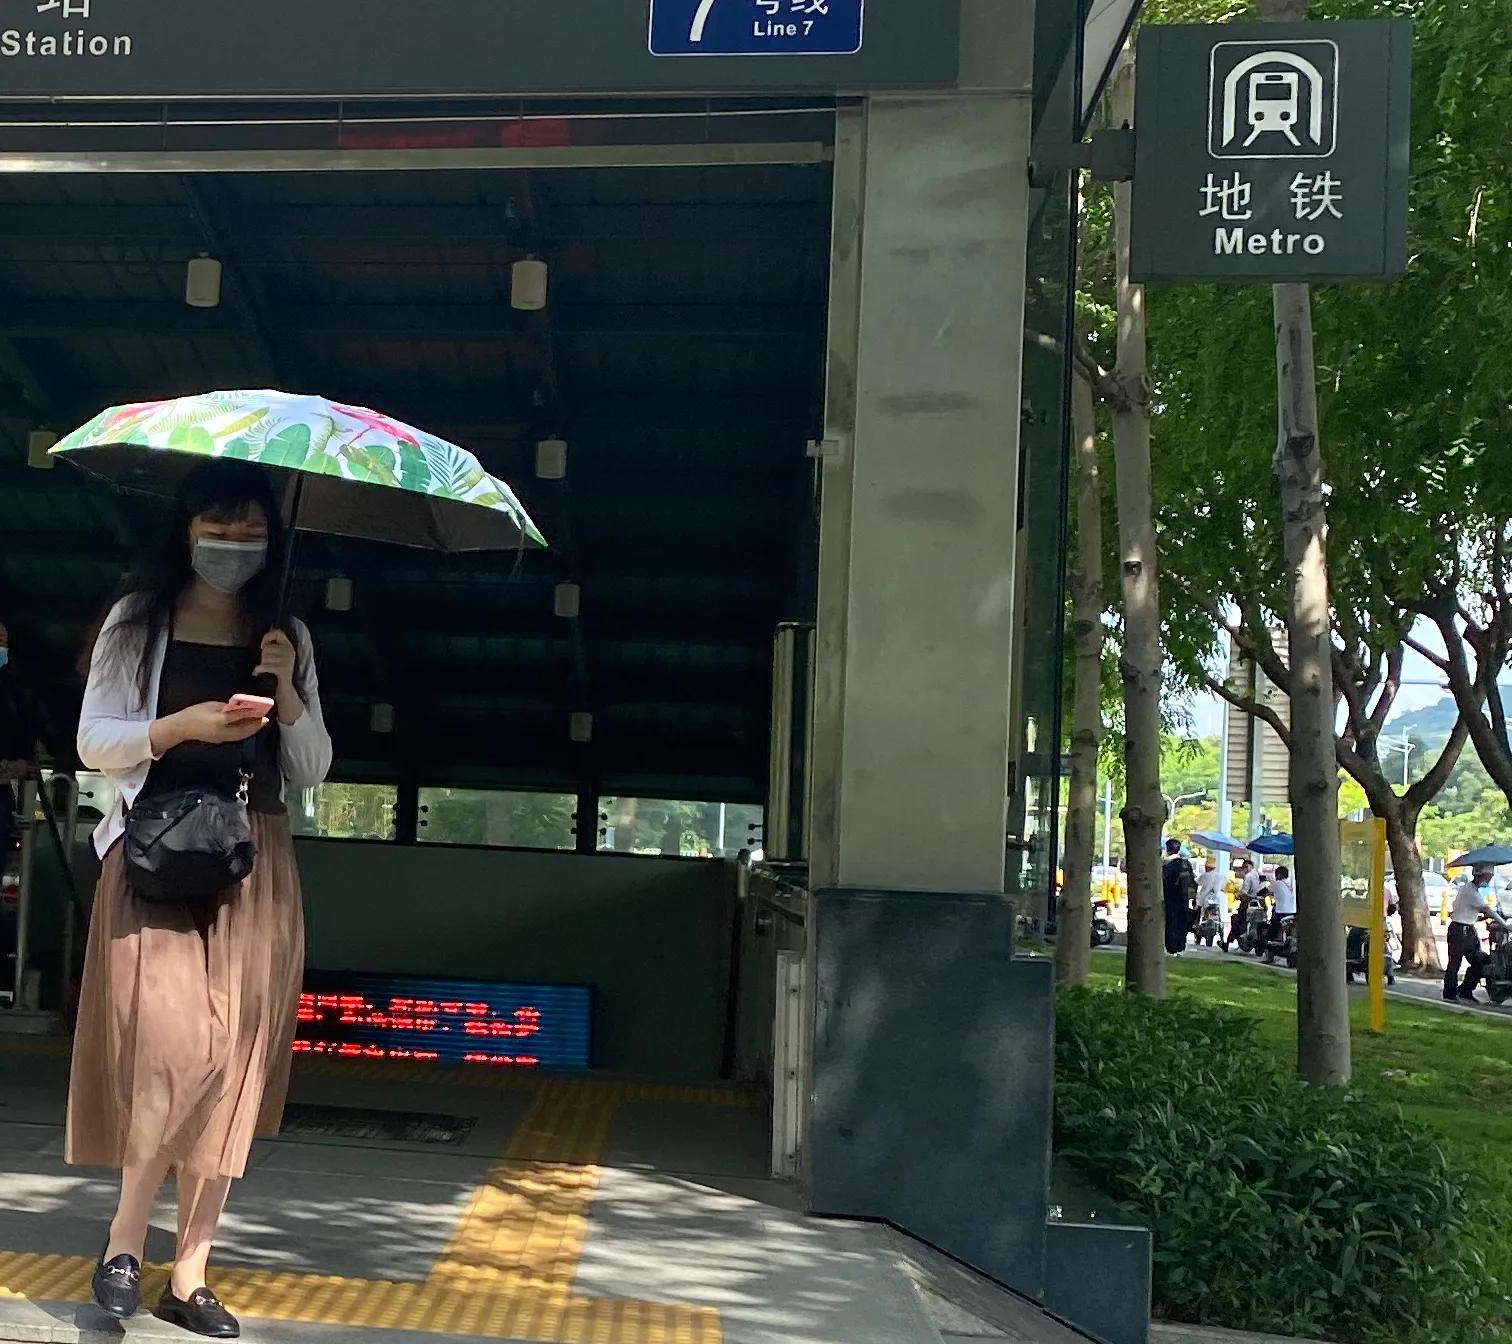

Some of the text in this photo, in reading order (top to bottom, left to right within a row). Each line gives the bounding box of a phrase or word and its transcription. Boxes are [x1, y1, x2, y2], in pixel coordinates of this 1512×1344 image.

[0, 29, 133, 57] Station
[752, 19, 815, 39] Line 7
[1197, 169, 1345, 222] 地铁
[1213, 226, 1326, 256] Metro
